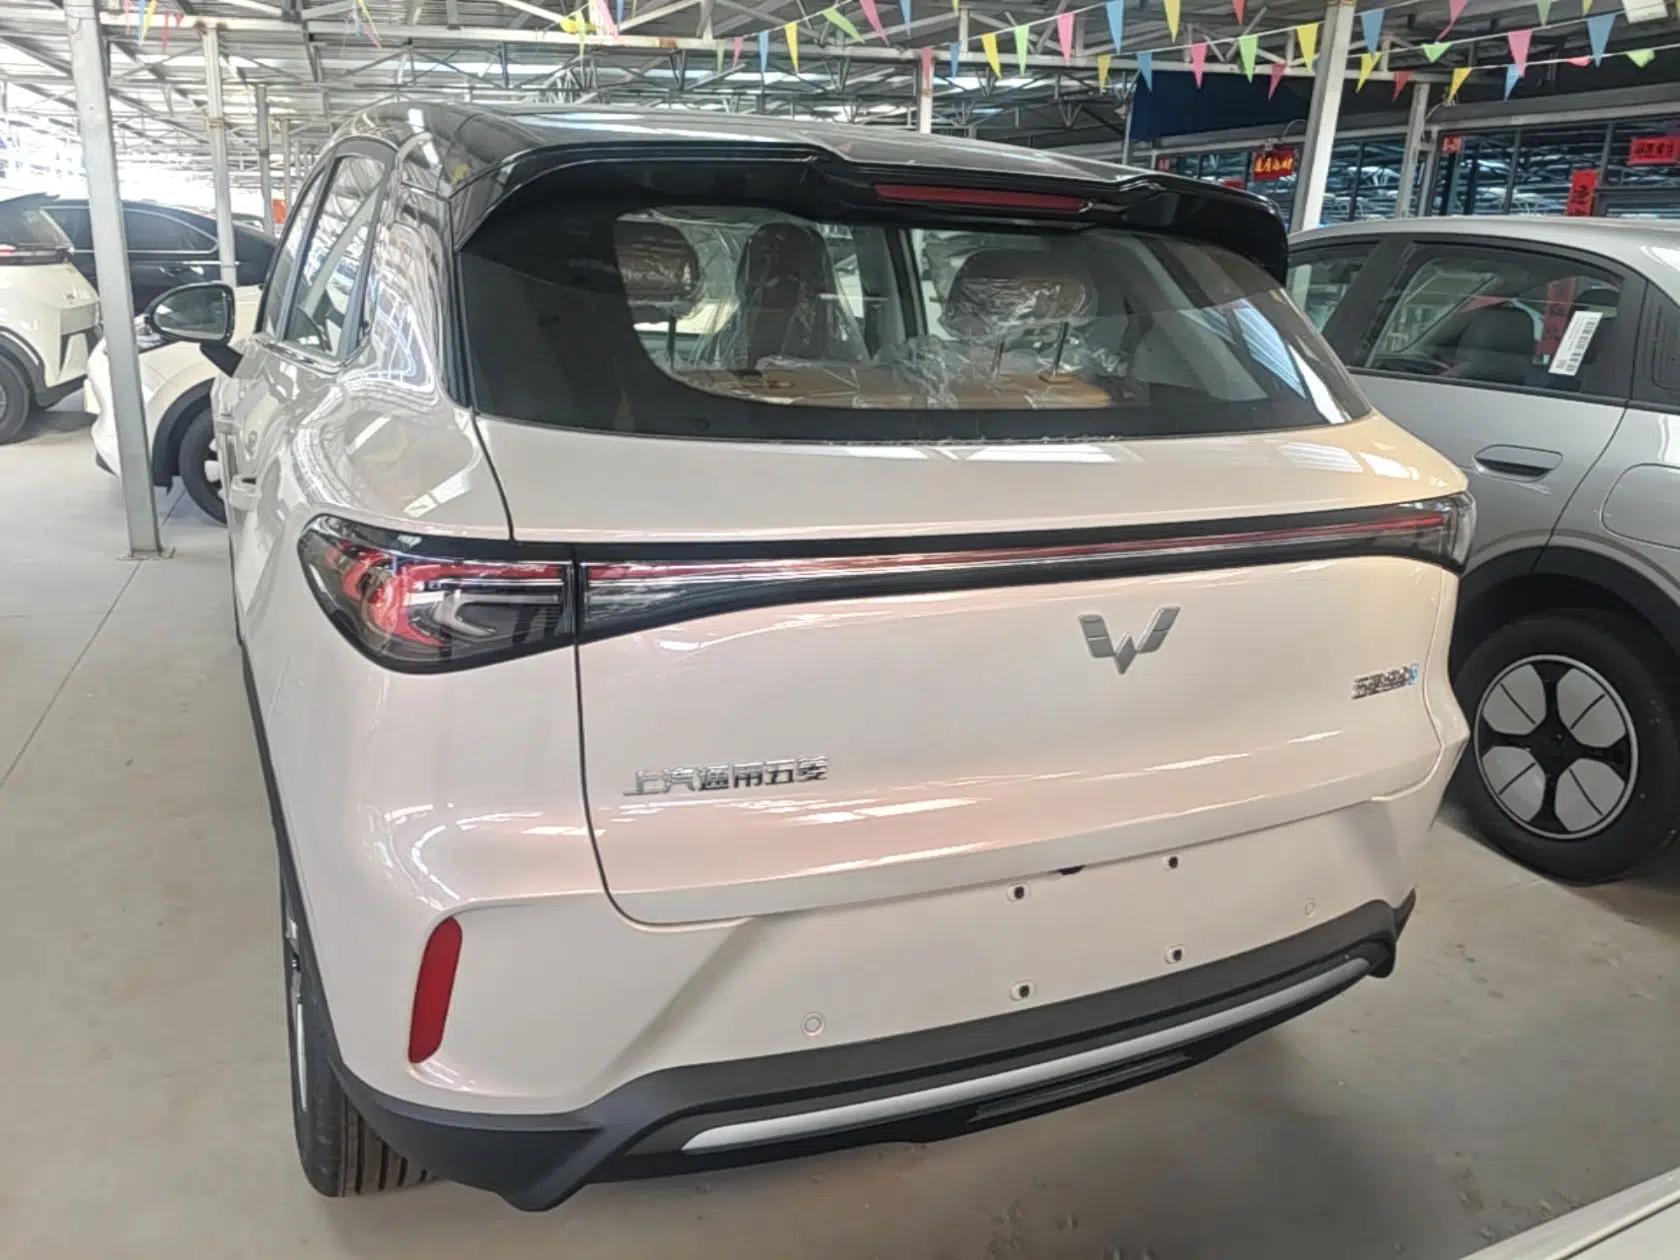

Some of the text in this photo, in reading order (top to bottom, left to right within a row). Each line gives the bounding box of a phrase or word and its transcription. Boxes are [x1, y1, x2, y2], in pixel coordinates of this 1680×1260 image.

[623, 755, 829, 796] 上汽通用五菱
